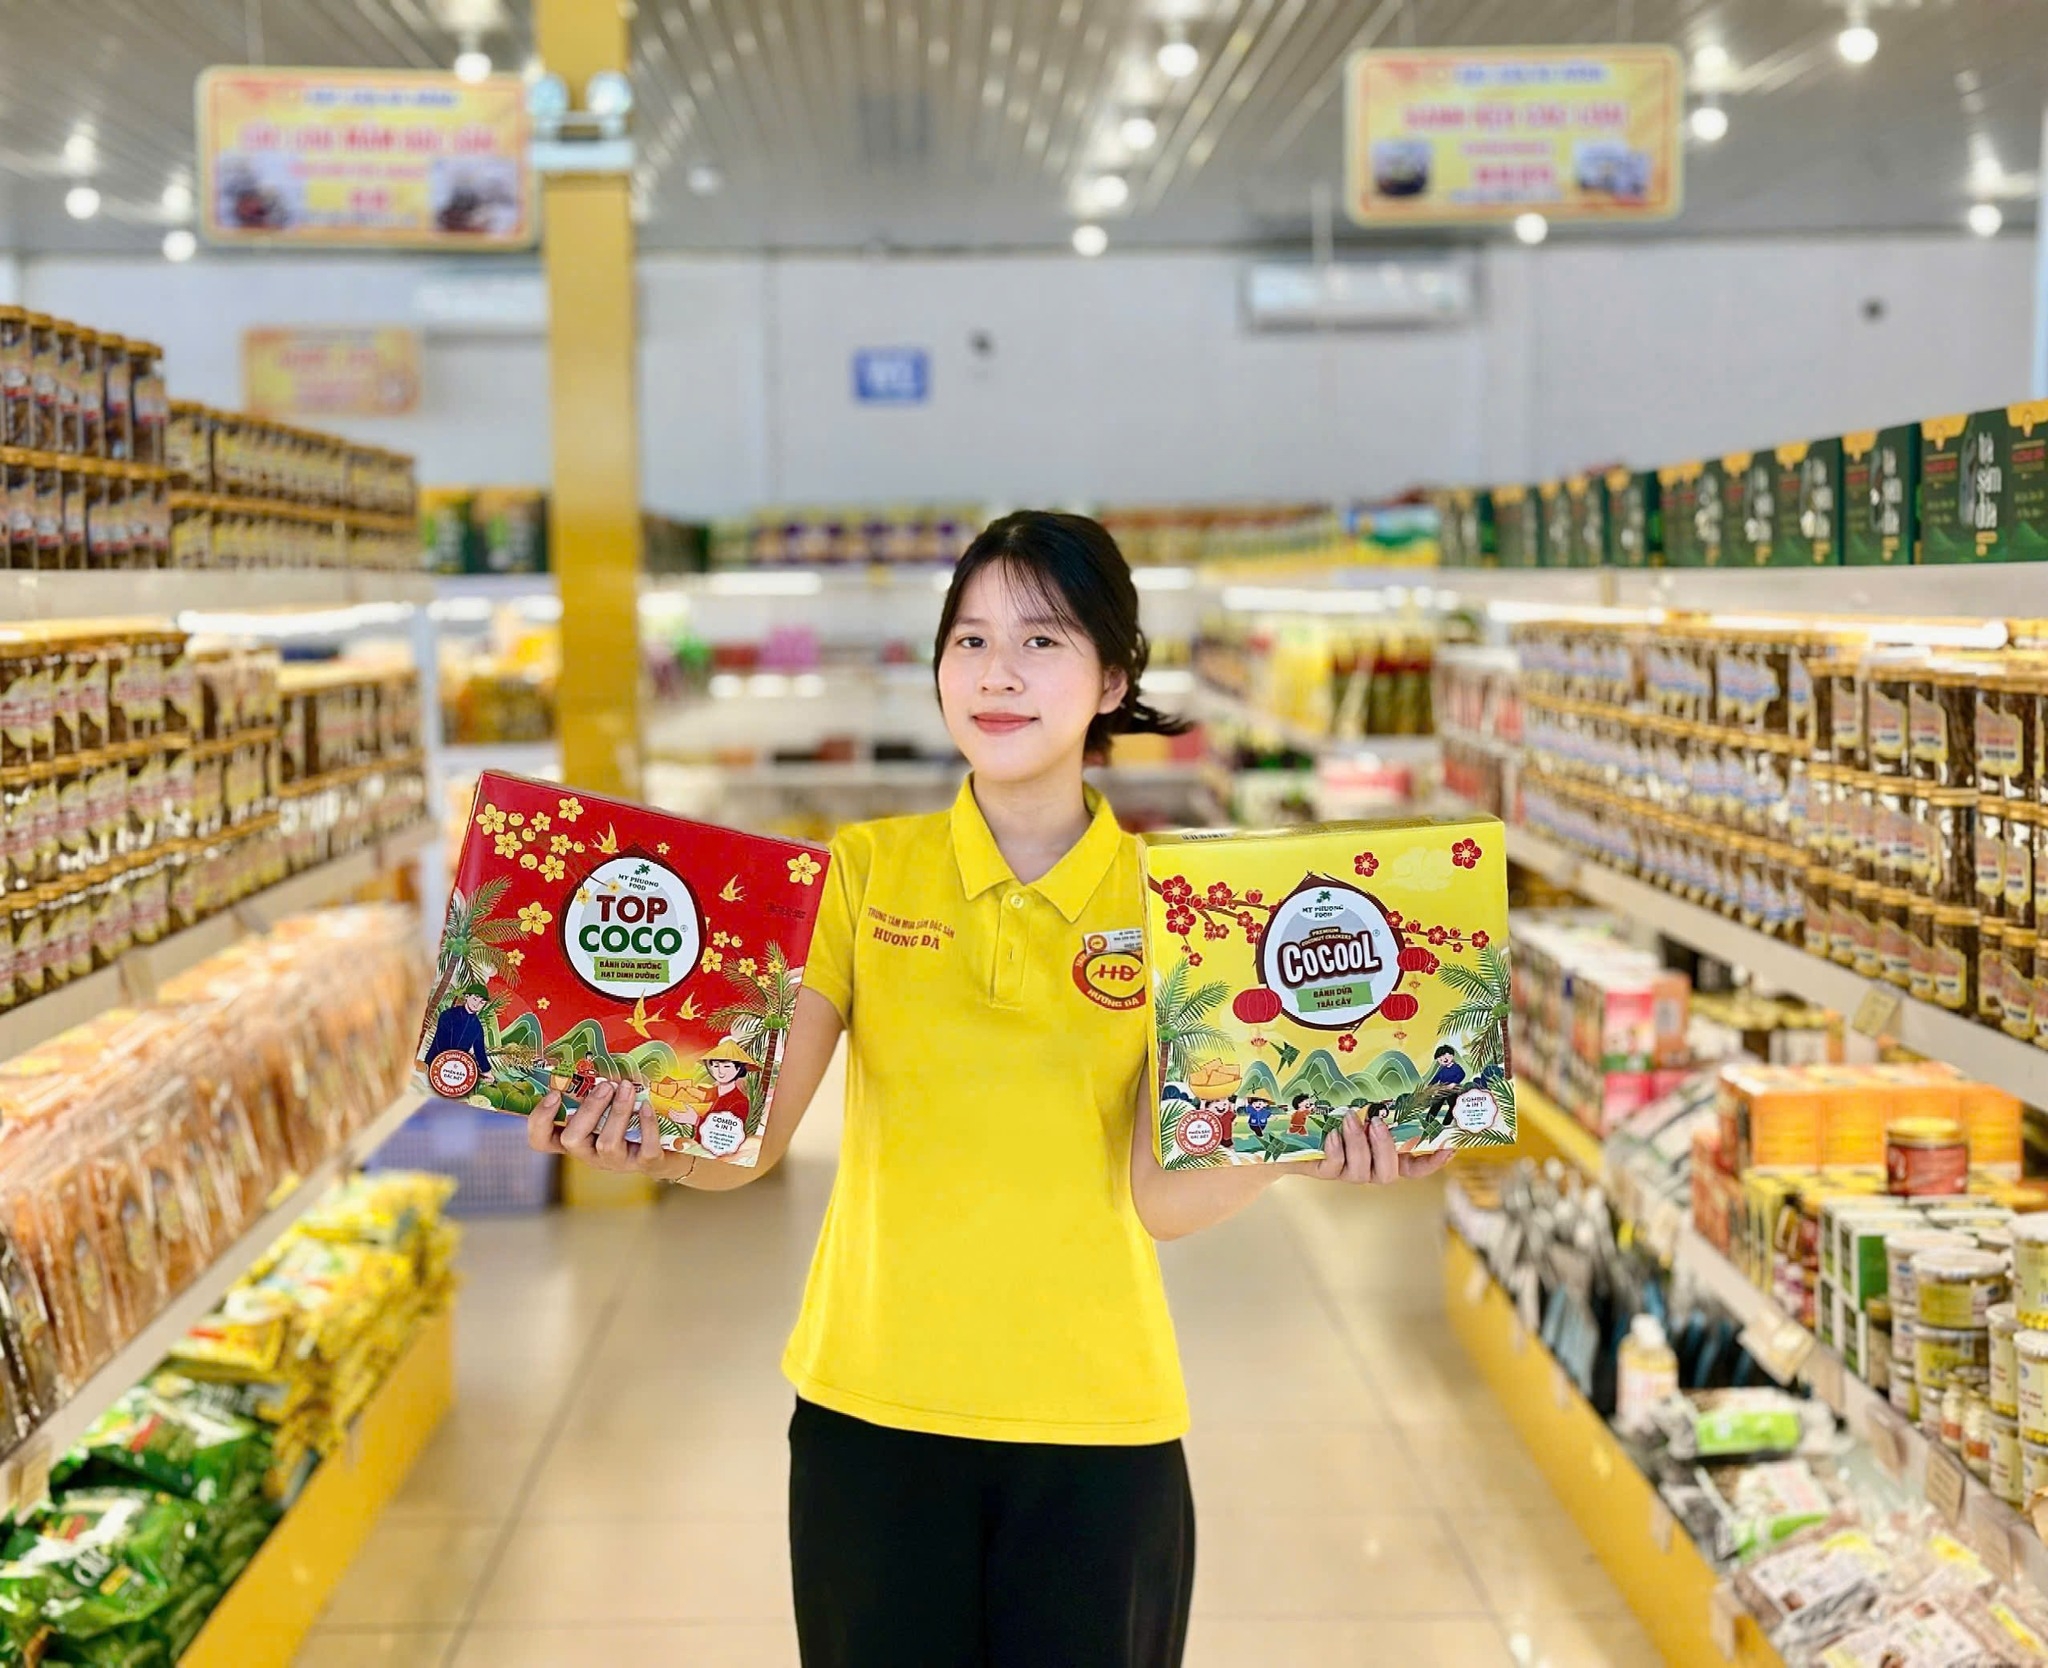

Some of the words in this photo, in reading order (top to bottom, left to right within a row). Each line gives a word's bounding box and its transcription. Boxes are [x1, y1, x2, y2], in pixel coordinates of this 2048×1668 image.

[628, 883, 647, 891] FOOD
[596, 895, 668, 924] TOP
[1312, 927, 1339, 936] PREMIUM
[578, 924, 683, 955] COCO
[1301, 935, 1325, 947] COCONUT
[1281, 933, 1380, 984] COCOOL
[599, 960, 619, 968] BÁNH
[601, 971, 615, 979] HẠT
[1313, 989, 1336, 998] BÁNH
[712, 1115, 738, 1127] COMBO
